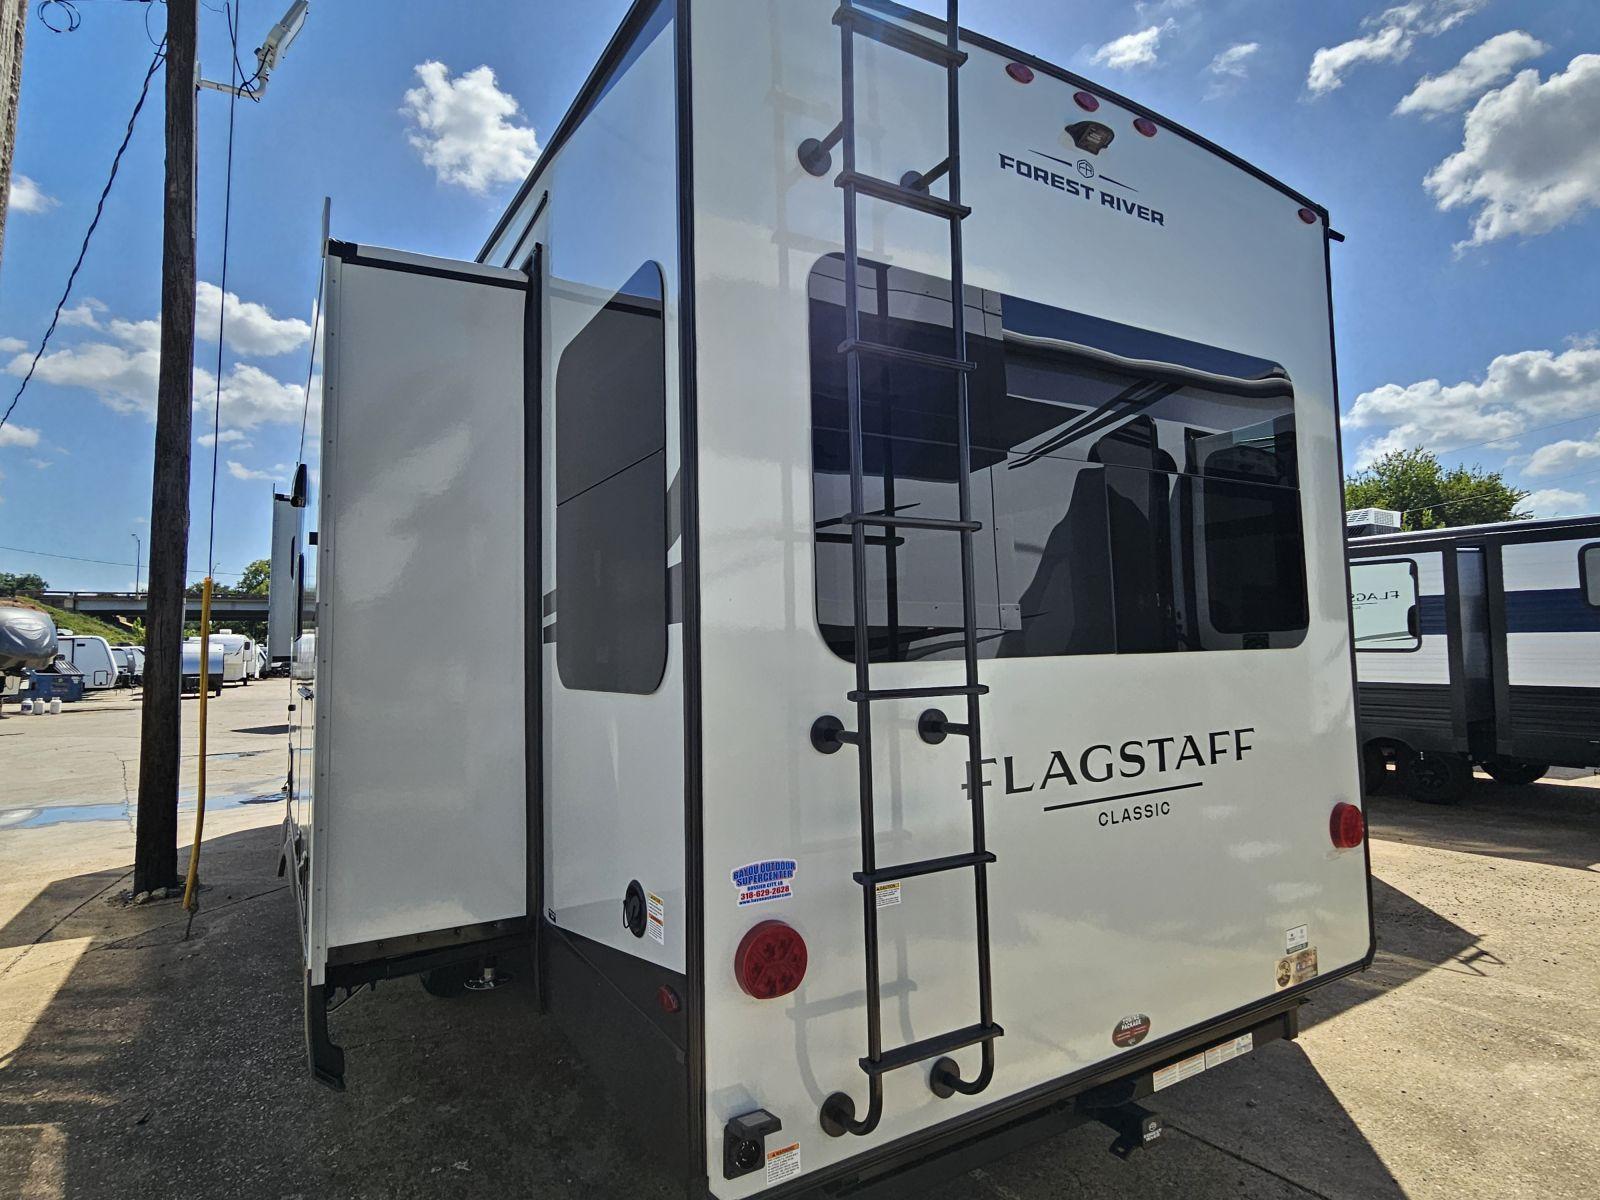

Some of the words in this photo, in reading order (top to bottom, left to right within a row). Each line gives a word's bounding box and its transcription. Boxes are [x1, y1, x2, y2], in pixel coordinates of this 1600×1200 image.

[998, 153, 1095, 200] FOREST
[1099, 190, 1165, 226] RIVER
[961, 727, 1255, 800] FLAGSTAFF
[1098, 801, 1170, 826] CLASSIC
[733, 864, 759, 880] BAYOU
[760, 861, 796, 873] OUTDOOR
[736, 869, 794, 887] SUPERCENTER
